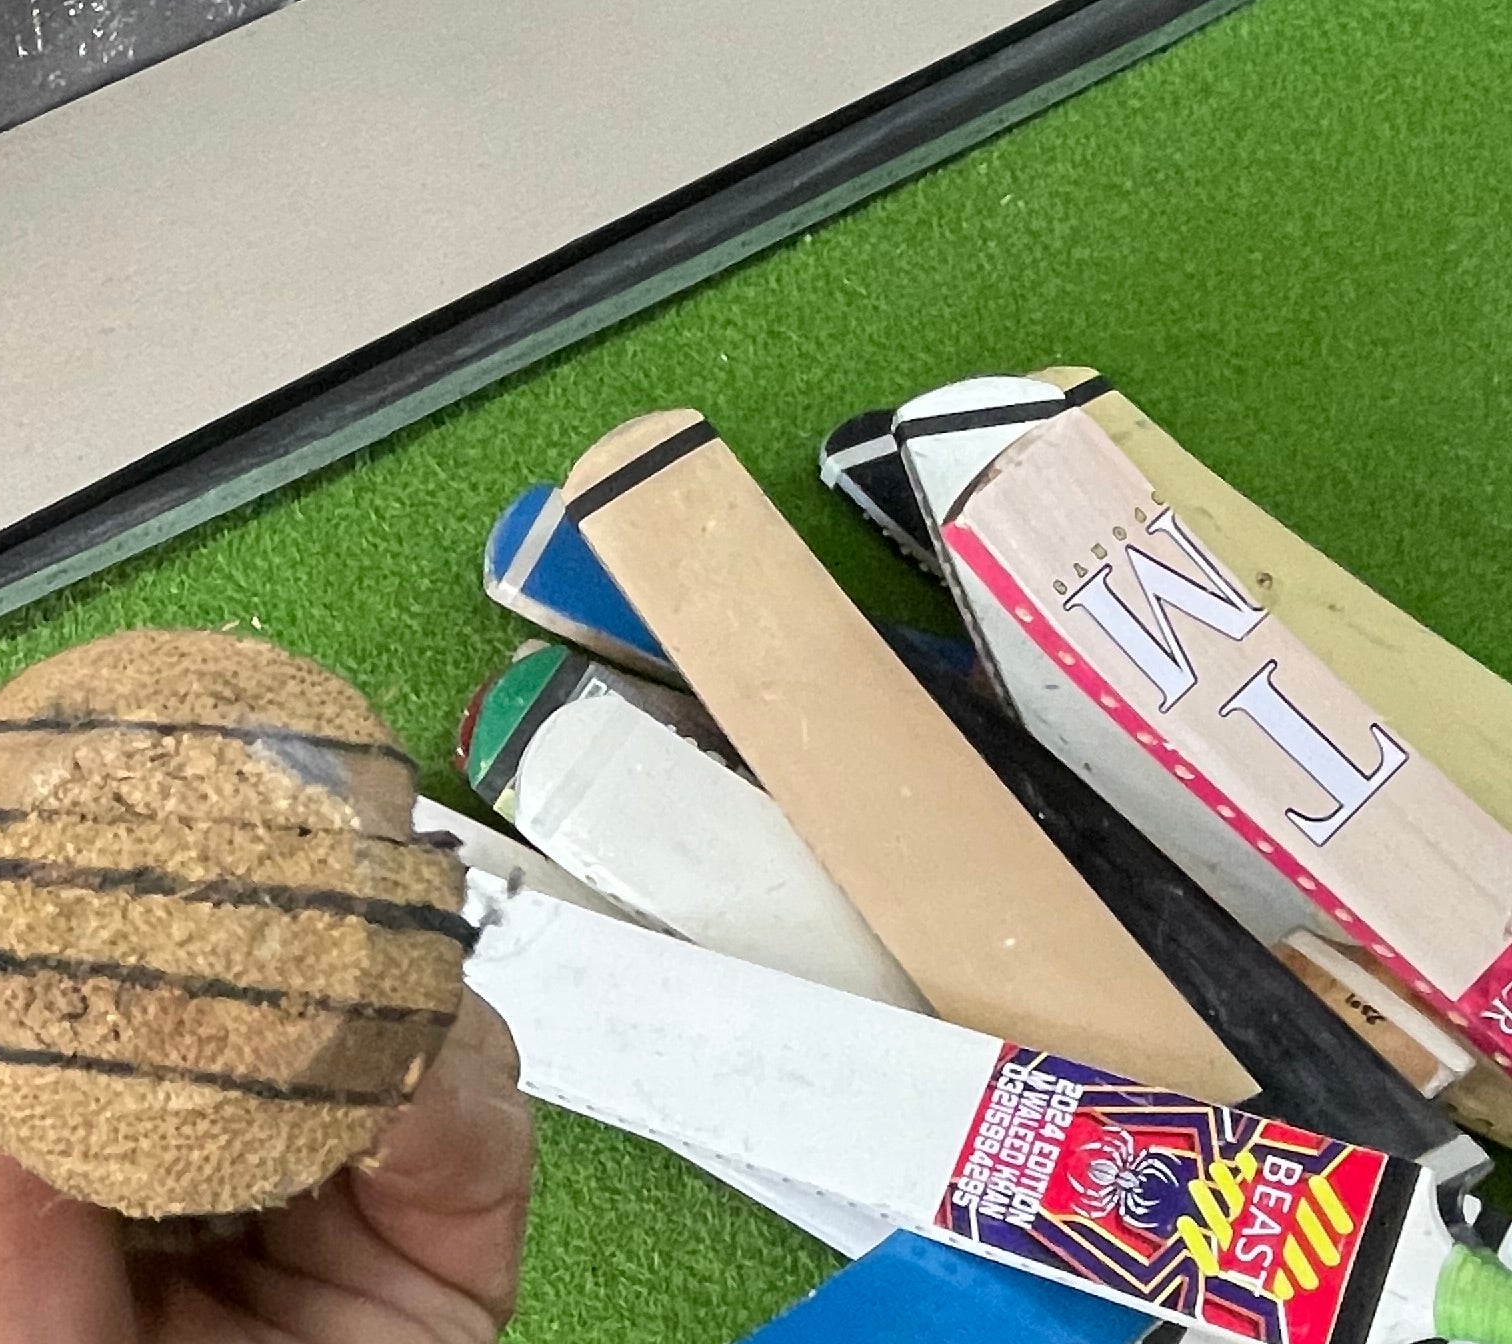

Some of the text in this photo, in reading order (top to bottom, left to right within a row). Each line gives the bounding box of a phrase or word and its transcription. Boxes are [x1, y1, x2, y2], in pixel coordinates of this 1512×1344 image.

[998, 1090, 1051, 1167] WALEED
[1004, 1078, 1085, 1230] 2024 EDITION
[978, 1163, 1021, 1221] KHAN
[1231, 1153, 1304, 1299] BEAST
